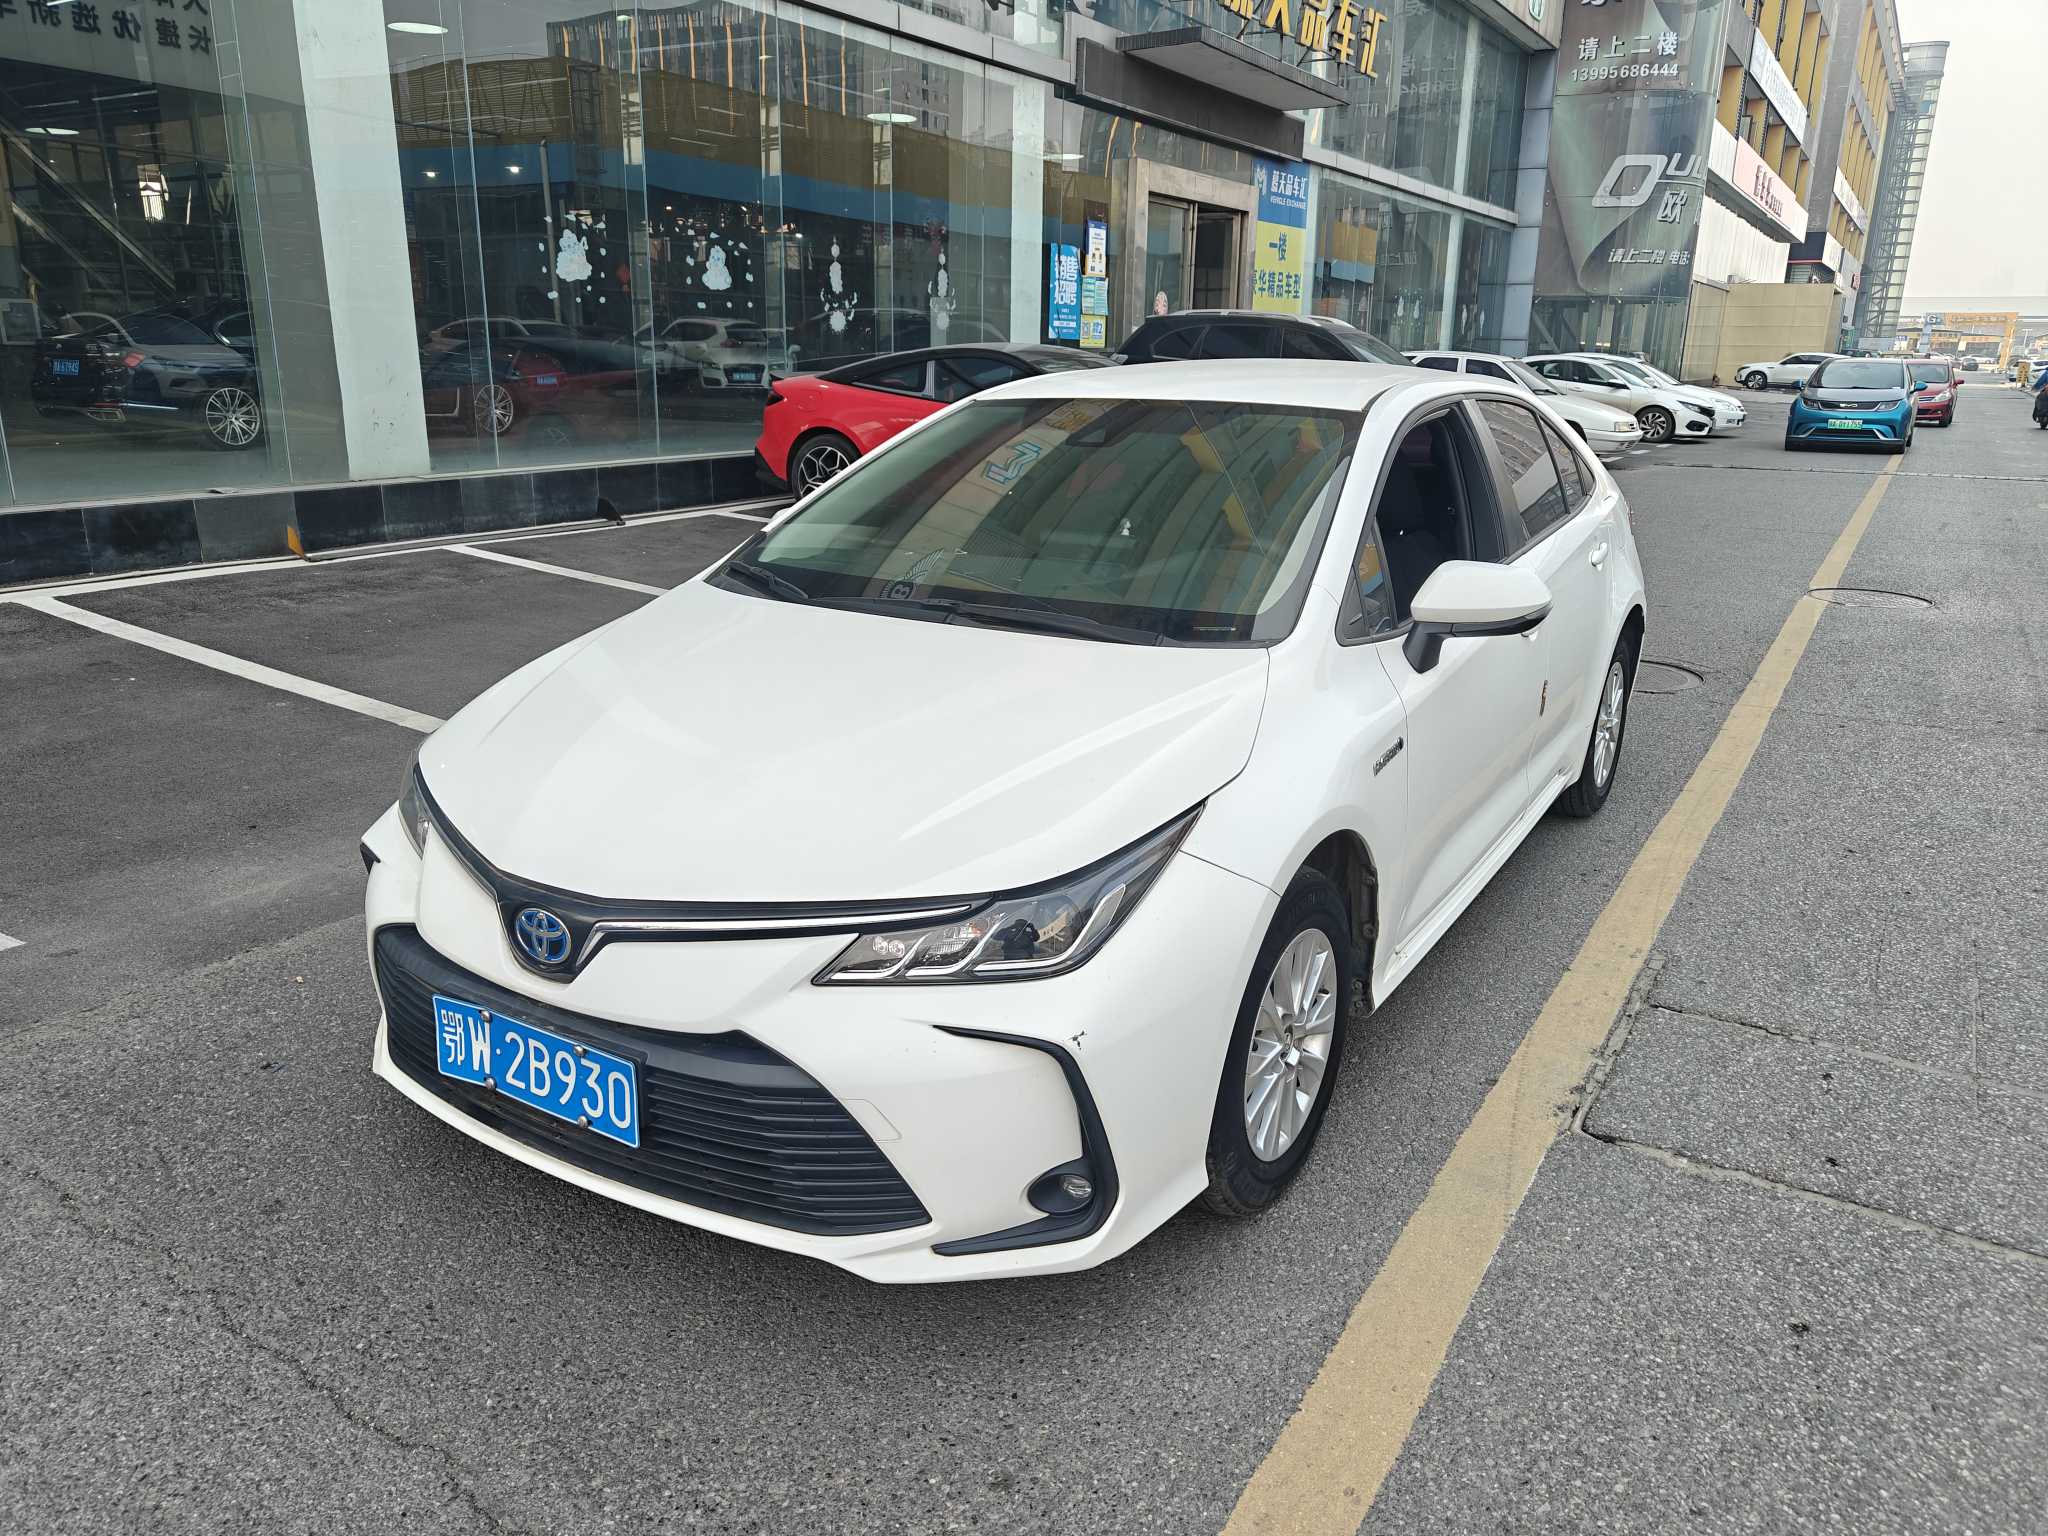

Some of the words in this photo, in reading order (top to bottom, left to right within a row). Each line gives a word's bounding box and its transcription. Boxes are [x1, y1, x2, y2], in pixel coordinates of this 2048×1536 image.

[1578, 31, 1679, 61] 请上二楼
[1570, 63, 1679, 82] 13995686444
[1608, 248, 1666, 264] 请上二楼
